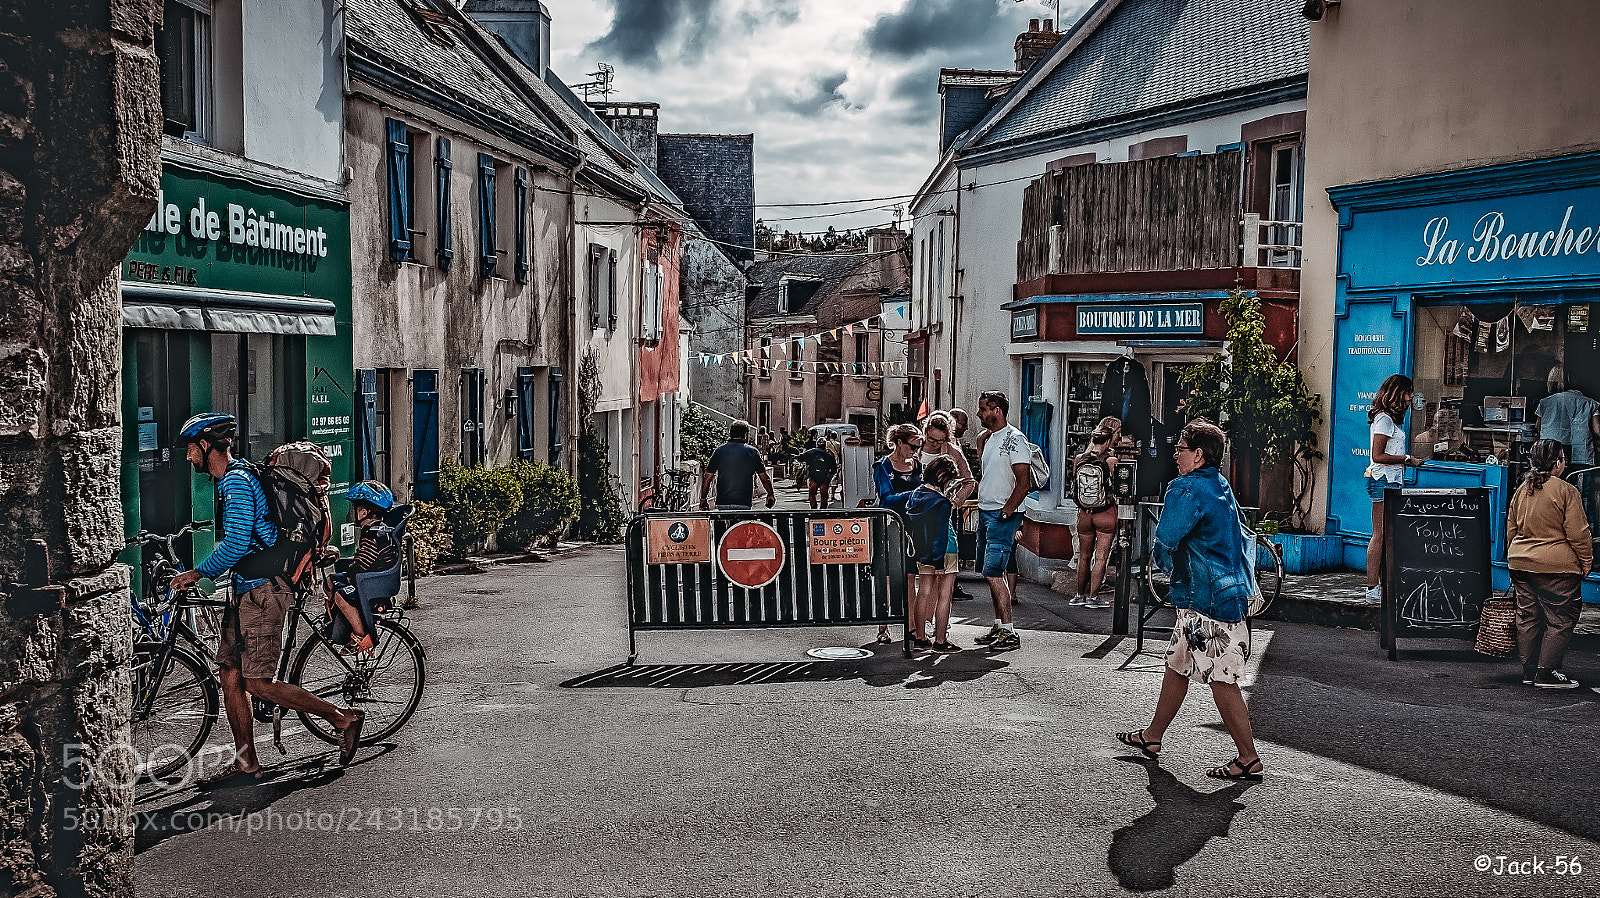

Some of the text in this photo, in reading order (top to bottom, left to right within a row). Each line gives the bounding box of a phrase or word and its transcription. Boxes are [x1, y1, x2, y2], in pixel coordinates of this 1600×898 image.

[190, 196, 220, 241] de
[228, 202, 327, 258] Bâtiment
[1415, 216, 1464, 267] La
[1079, 309, 1202, 328] BOUTIQUE DE LA MER
[1354, 334, 1385, 342] BOUCHERIE
[1348, 347, 1392, 355] TRADITIONNELLE
[311, 417, 319, 426] 02
[320, 417, 327, 426] 97
[323, 444, 343, 458] SILVA
[1400, 498, 1480, 514] Aujourd'hui
[813, 537, 866, 547] Bourg piéton
